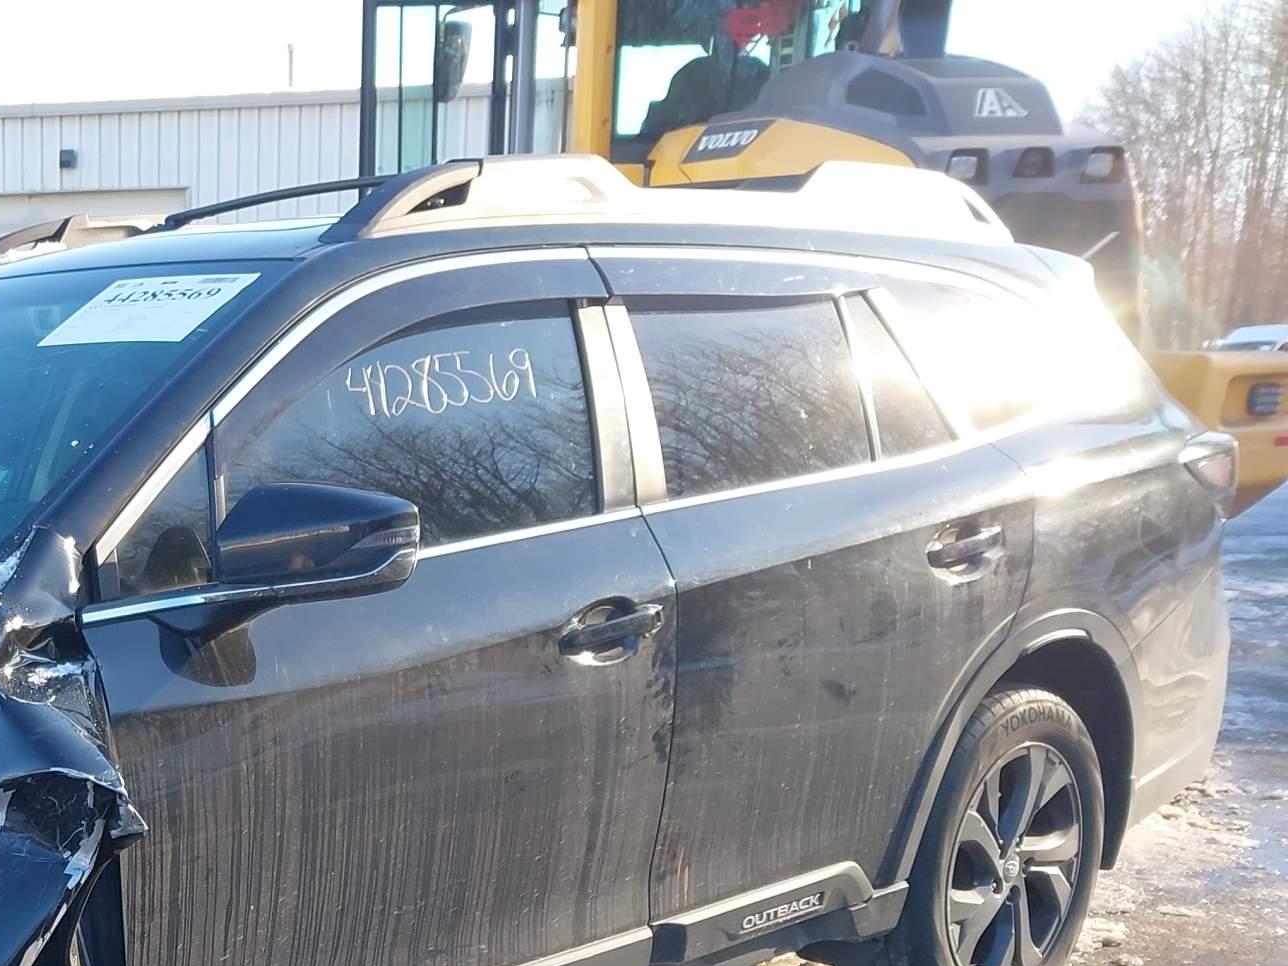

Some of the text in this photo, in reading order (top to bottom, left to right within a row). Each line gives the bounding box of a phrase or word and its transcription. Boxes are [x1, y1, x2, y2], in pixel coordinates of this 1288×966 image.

[697, 130, 759, 152] VOLVO
[103, 287, 222, 305] 44285569
[1000, 704, 1073, 737] YOKOHAMA
[742, 893, 822, 929] OUTBACK
